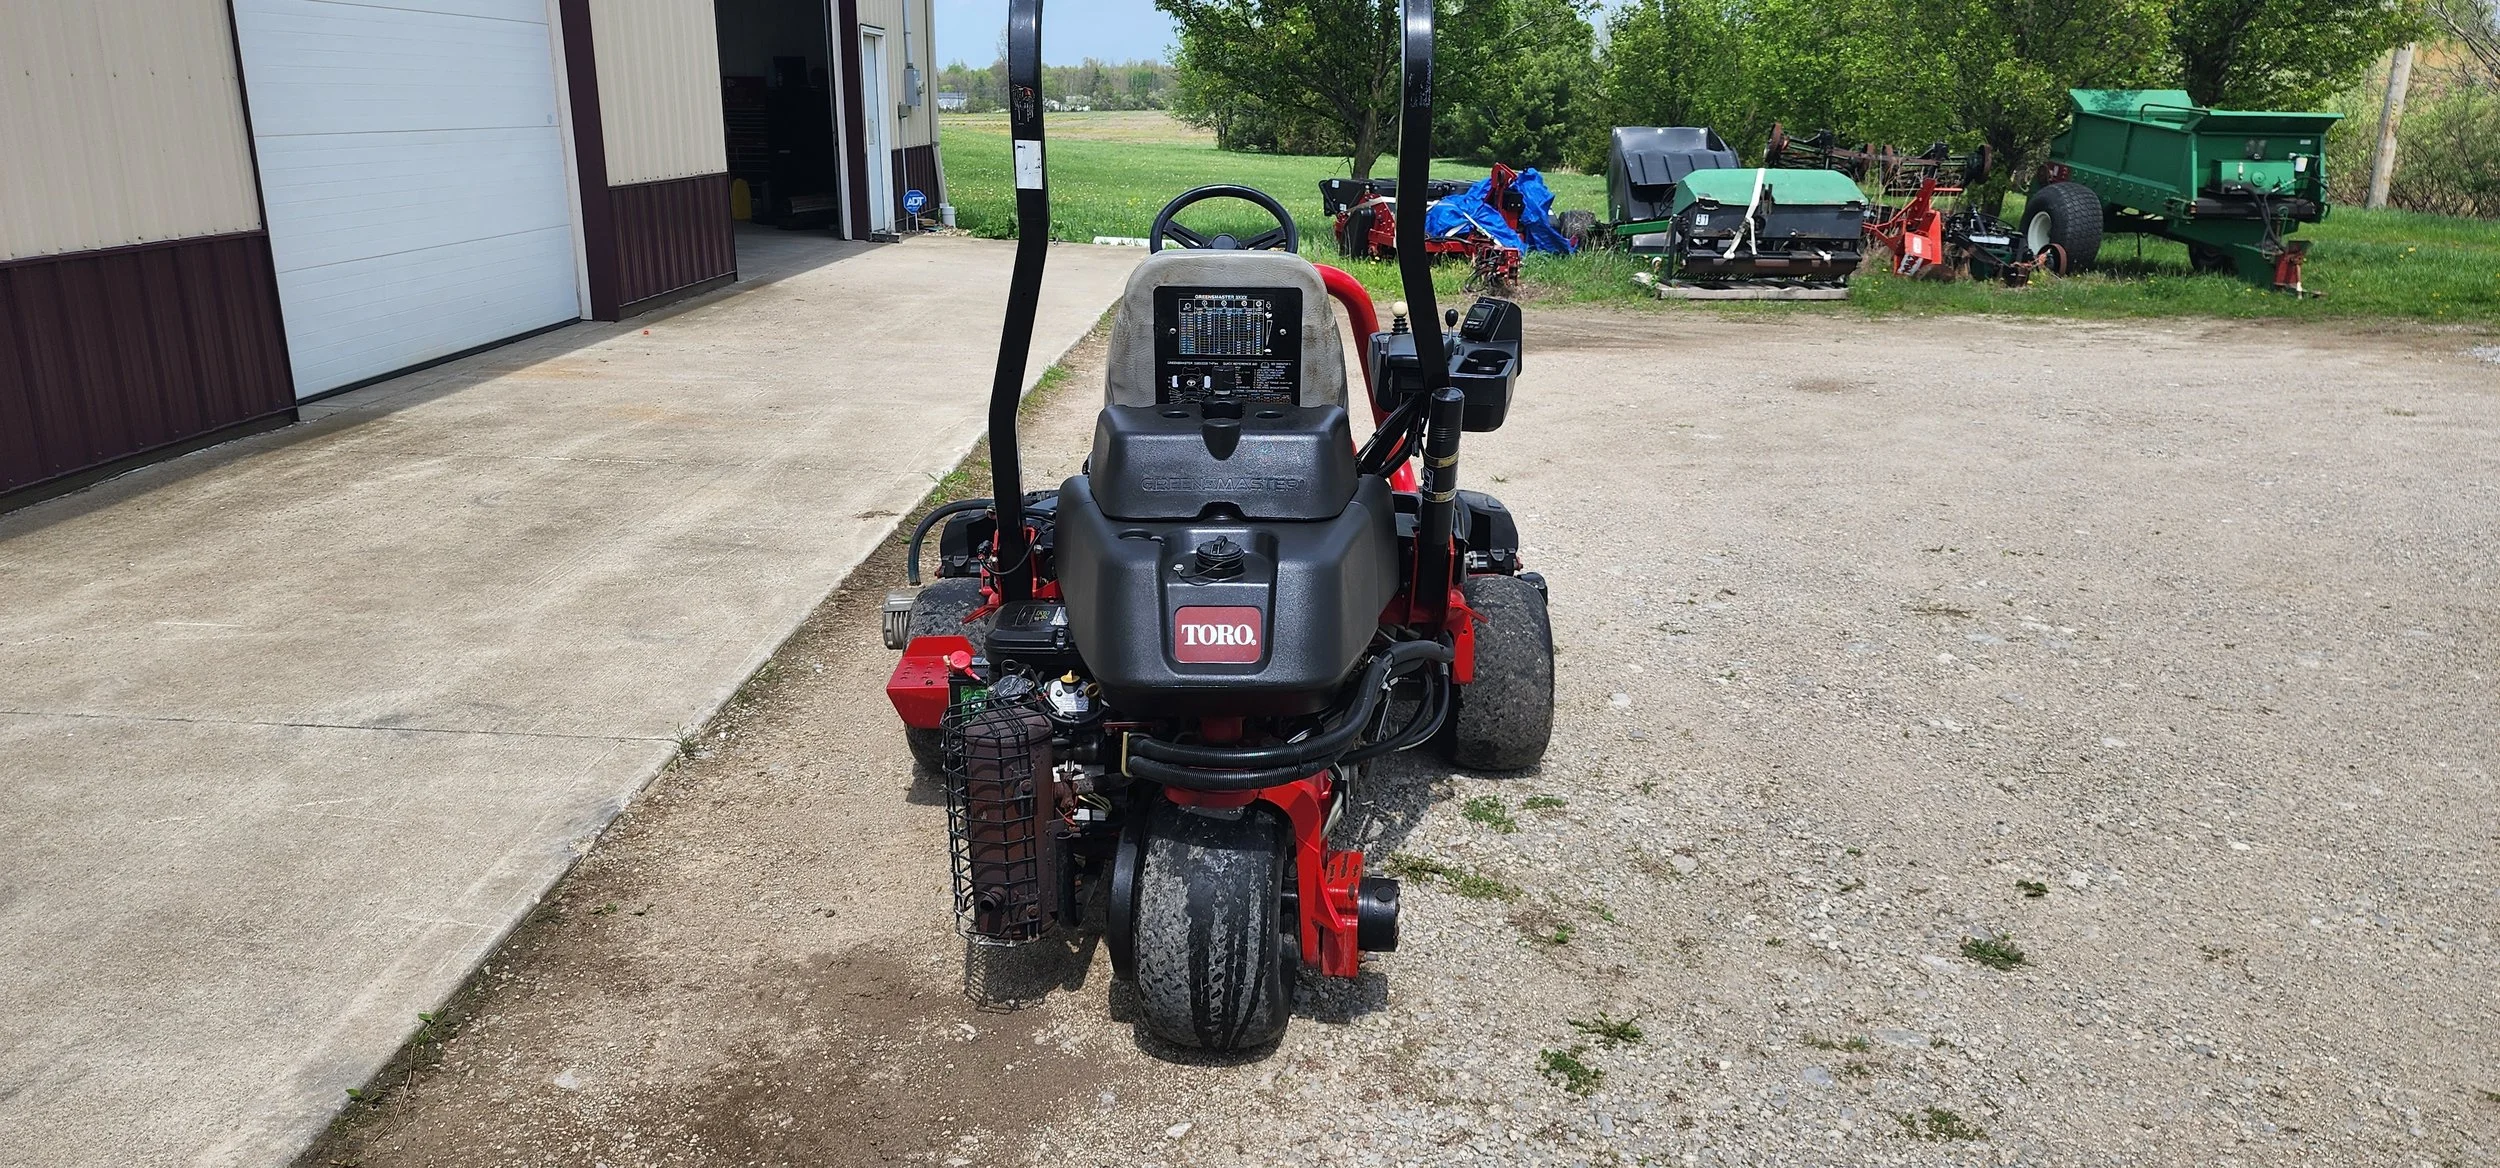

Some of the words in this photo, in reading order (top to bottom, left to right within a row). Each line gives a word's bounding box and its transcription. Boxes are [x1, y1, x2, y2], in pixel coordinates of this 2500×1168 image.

[907, 196, 924, 206] ADT
[1140, 476, 1300, 492] GREENSMASTER
[1181, 623, 1255, 646] TORO
